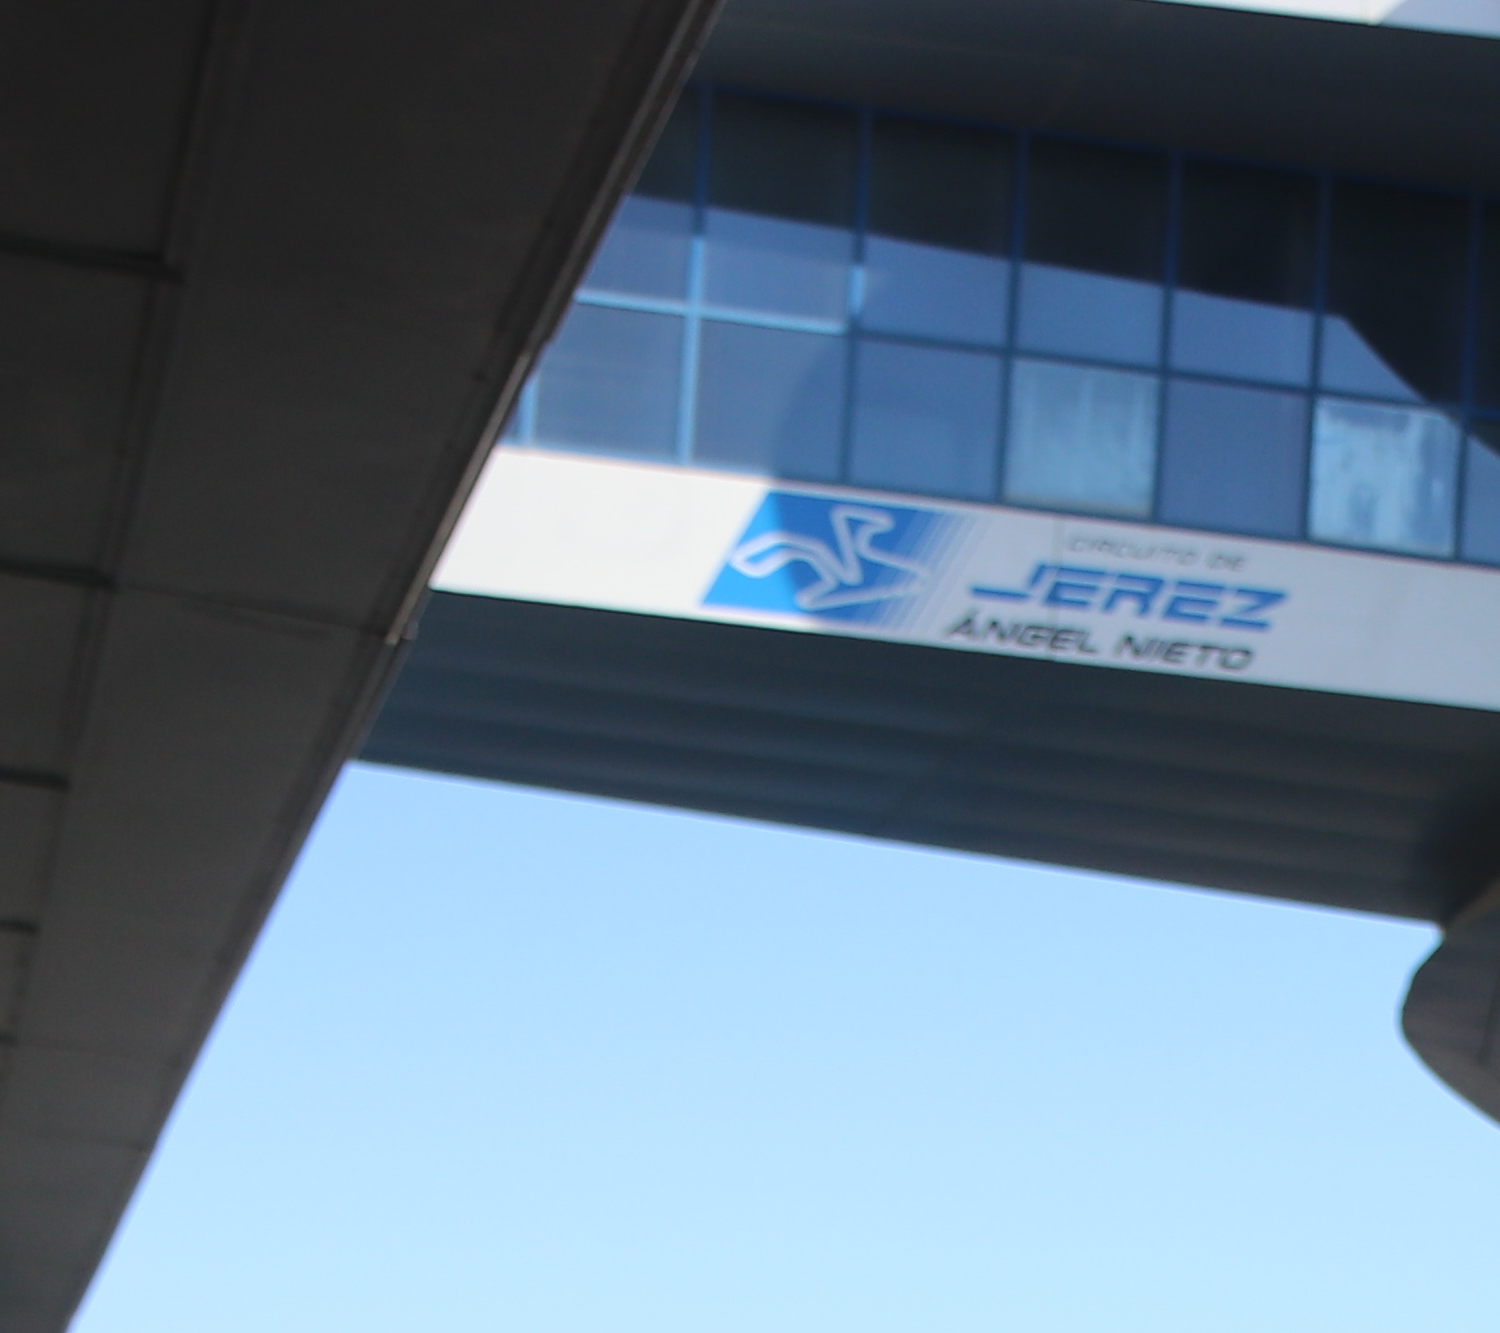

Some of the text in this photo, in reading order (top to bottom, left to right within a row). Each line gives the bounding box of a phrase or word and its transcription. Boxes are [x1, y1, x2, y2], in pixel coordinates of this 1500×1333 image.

[1206, 551, 1247, 573] DE
[969, 561, 1290, 633] JEREZ
[1113, 634, 1256, 672] NIETO
